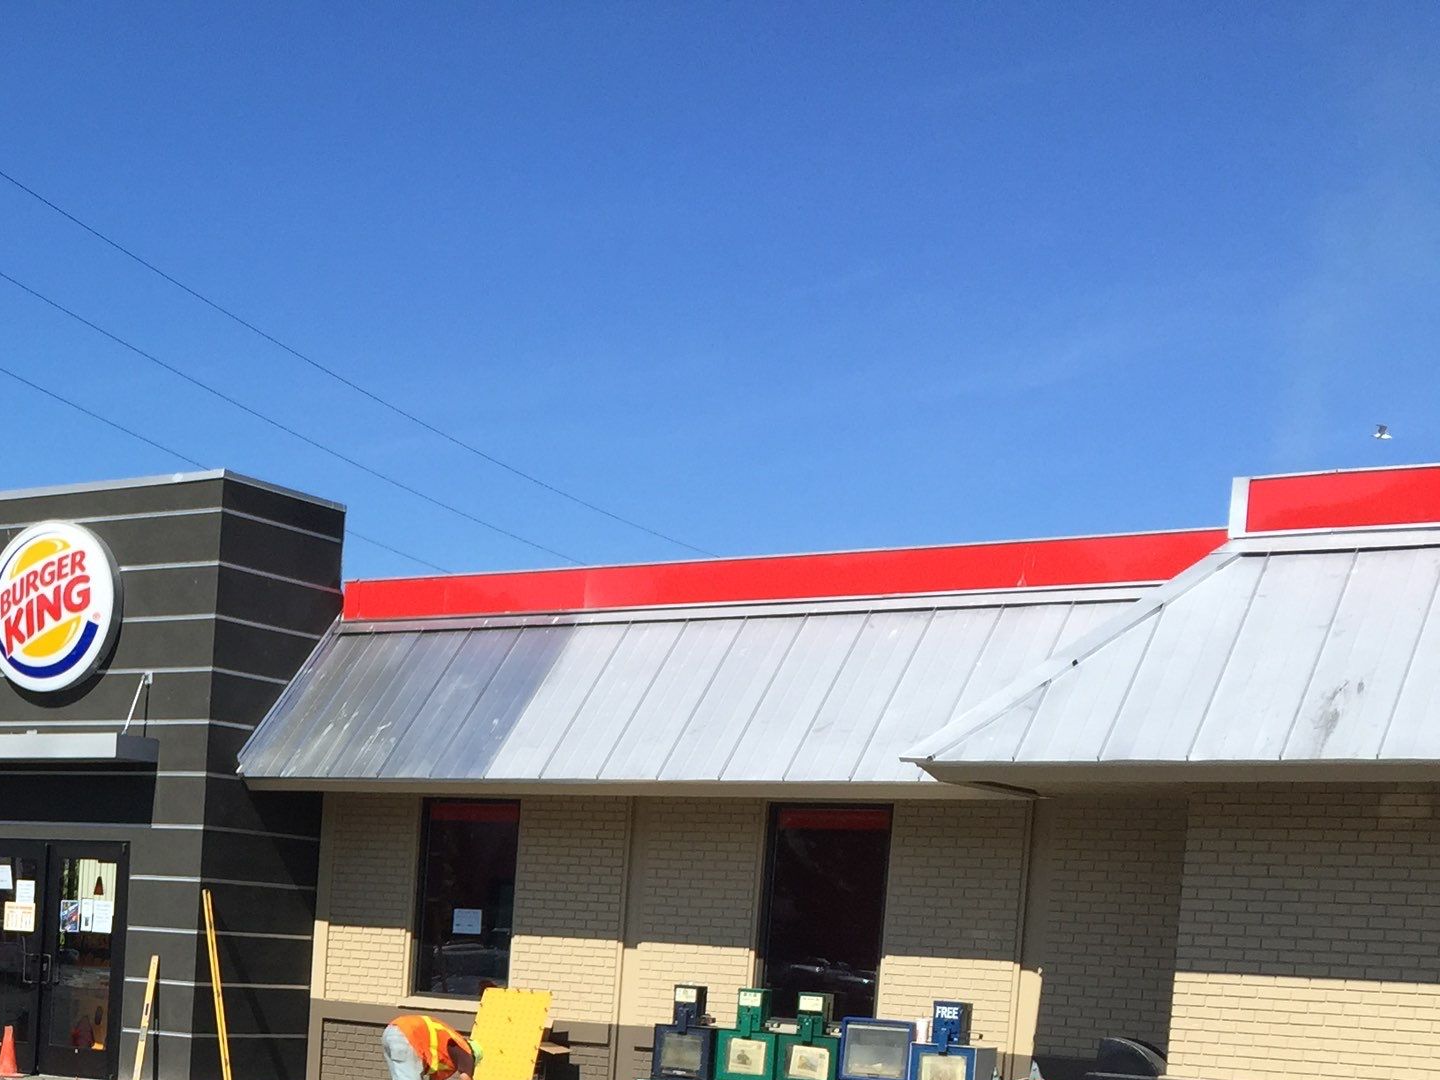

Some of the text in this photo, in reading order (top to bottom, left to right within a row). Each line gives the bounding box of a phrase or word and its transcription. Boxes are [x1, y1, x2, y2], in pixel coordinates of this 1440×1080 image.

[0, 550, 86, 620] BURGER
[3, 574, 91, 659] KING
[935, 1005, 959, 1020] FREE
